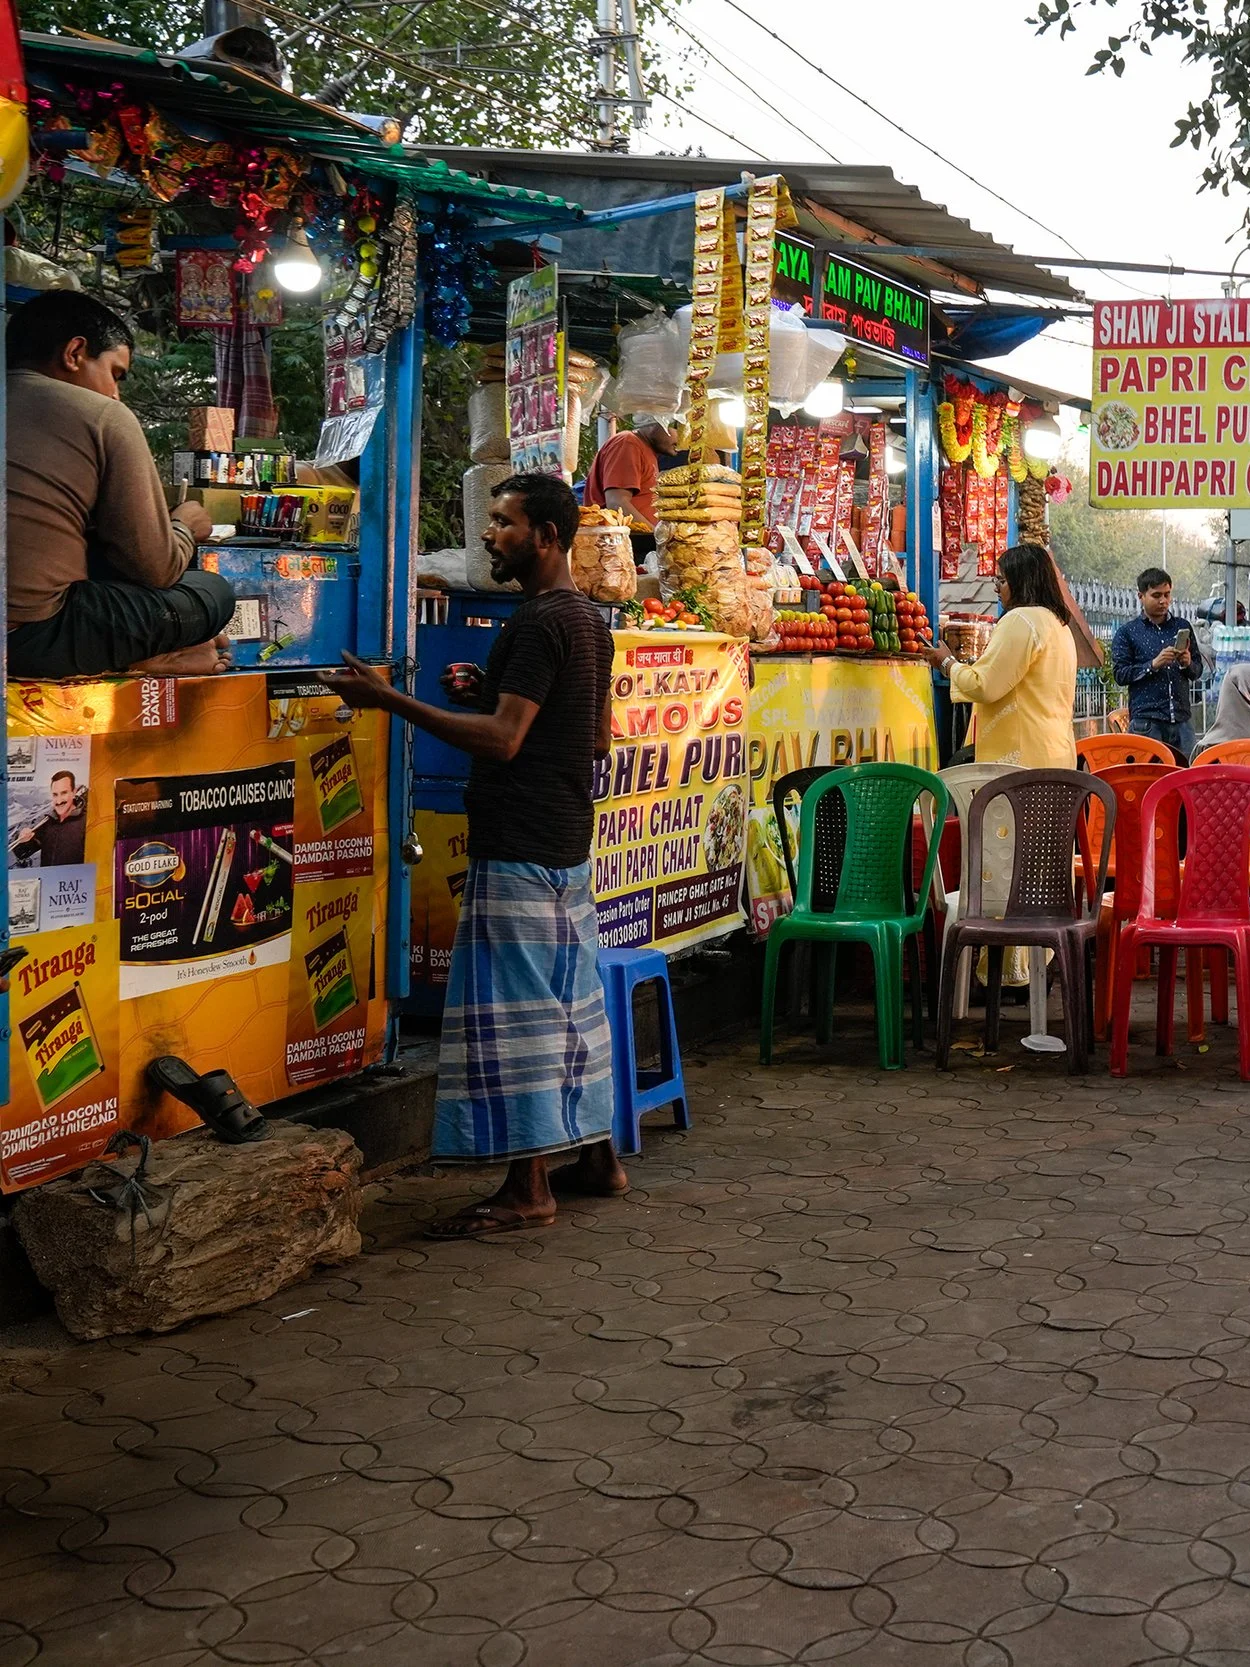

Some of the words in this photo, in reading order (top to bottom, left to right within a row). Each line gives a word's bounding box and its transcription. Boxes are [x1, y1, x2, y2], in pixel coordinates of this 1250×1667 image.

[773, 241, 810, 285] AYA
[823, 262, 851, 301] AM
[855, 273, 881, 312] PAV
[884, 285, 924, 330] BHAJI
[1099, 306, 1160, 345] SHAW
[1166, 305, 1185, 344] JI
[1100, 356, 1207, 393] PAPRI
[1144, 405, 1207, 444] BHEL
[1097, 460, 1235, 496] DAHIPAPRI
[637, 652, 651, 665] जय
[654, 650, 671, 663] माता
[673, 648, 682, 663] दी
[151, 677, 161, 726] DAMD
[750, 671, 789, 712] ELCOME
[610, 697, 743, 740] AMOUS
[45, 738, 83, 750] NIWAS
[319, 763, 353, 798] Tiranga
[592, 742, 670, 803] BHEL
[680, 732, 747, 786] PURI
[750, 728, 820, 802] PAV
[122, 801, 151, 814] STATUTORY
[151, 799, 173, 811] WARNING
[179, 786, 227, 813] TOBACCO
[229, 782, 265, 806] CAUSES
[267, 778, 295, 801] CANCE
[598, 805, 644, 849] PAPRI
[650, 795, 704, 837] CHAAT
[294, 840, 332, 854] DAMDAR
[334, 837, 363, 849] LOGON
[364, 836, 372, 846] KI
[294, 850, 334, 865] DAMDAR
[336, 847, 372, 860] PASAND
[128, 860, 150, 873] GOLD
[153, 856, 178, 869] FLAKE
[595, 852, 622, 894] DAHI
[626, 843, 659, 885] PAPRI
[662, 834, 700, 876] CHAAT
[49, 892, 88, 907] NIWAS
[59, 880, 79, 893] RAJ
[657, 887, 688, 908] PRINCEP
[709, 876, 723, 894] GATE
[724, 872, 738, 889] No.2
[139, 909, 168, 925] 2-pod
[306, 891, 359, 933] Tiranga
[618, 900, 634, 920] Party
[635, 895, 650, 914] Order
[663, 910, 684, 929] SHAW
[685, 907, 693, 922] JI
[694, 901, 711, 919] STALL
[712, 899, 721, 913] No.
[722, 895, 730, 908] 45
[130, 936, 178, 952] REFRESHER
[132, 933, 149, 943] THE
[150, 928, 177, 940] GREAT
[413, 945, 424, 954] KI
[18, 940, 96, 997] Tiranga
[187, 962, 222, 978] Honeydew
[222, 955, 248, 970] Smooth
[314, 958, 347, 996] Tiranga
[35, 1018, 84, 1069] Tiranga
[286, 1048, 327, 1065] DAMDAR
[329, 1038, 364, 1055] PASAND
[287, 1036, 325, 1054] DAMDAR
[327, 1030, 355, 1045] LOGON
[356, 1028, 365, 1039] KI
[60, 1104, 100, 1124] LOGON
[105, 1097, 117, 1111] KI
